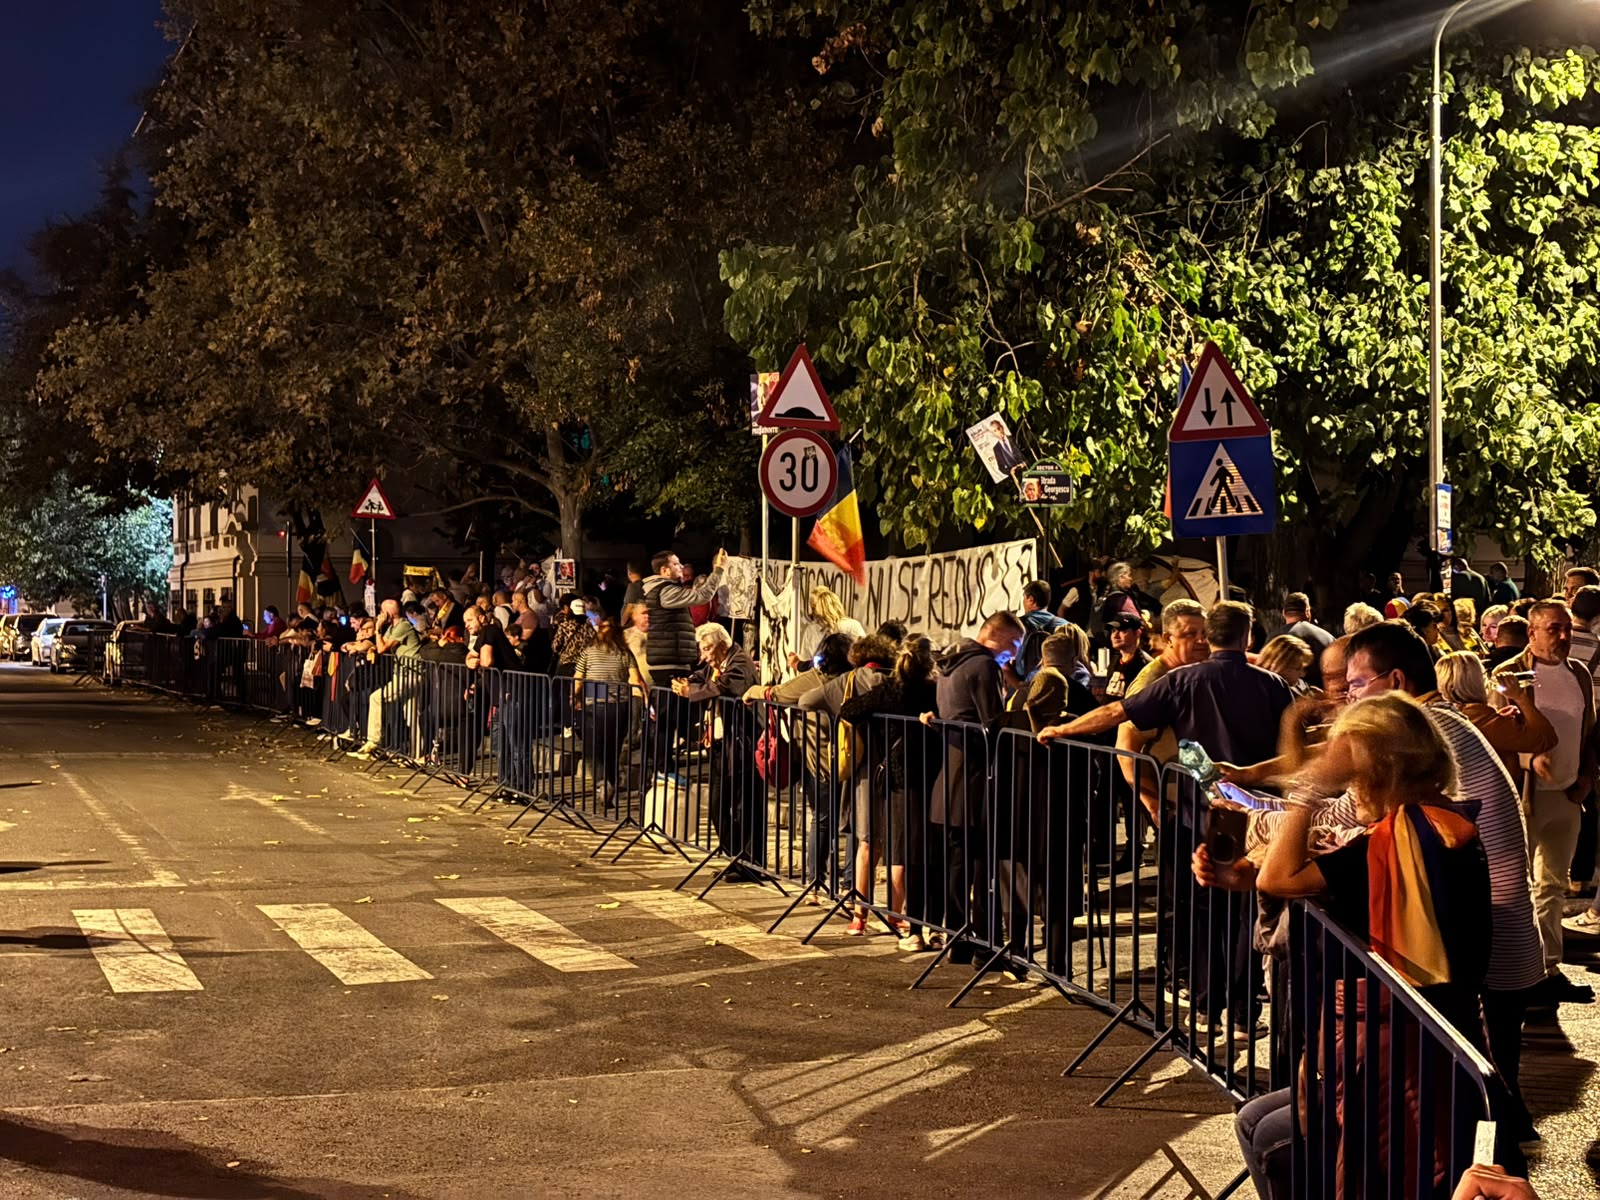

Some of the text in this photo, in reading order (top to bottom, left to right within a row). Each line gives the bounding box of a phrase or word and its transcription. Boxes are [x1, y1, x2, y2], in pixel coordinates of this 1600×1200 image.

[779, 452, 818, 493] 30
[1040, 476, 1057, 485] Strada
[1044, 485, 1070, 495] Georgescu
[866, 567, 893, 631] NU
[895, 560, 926, 624] SE
[927, 551, 995, 631] REDUC
